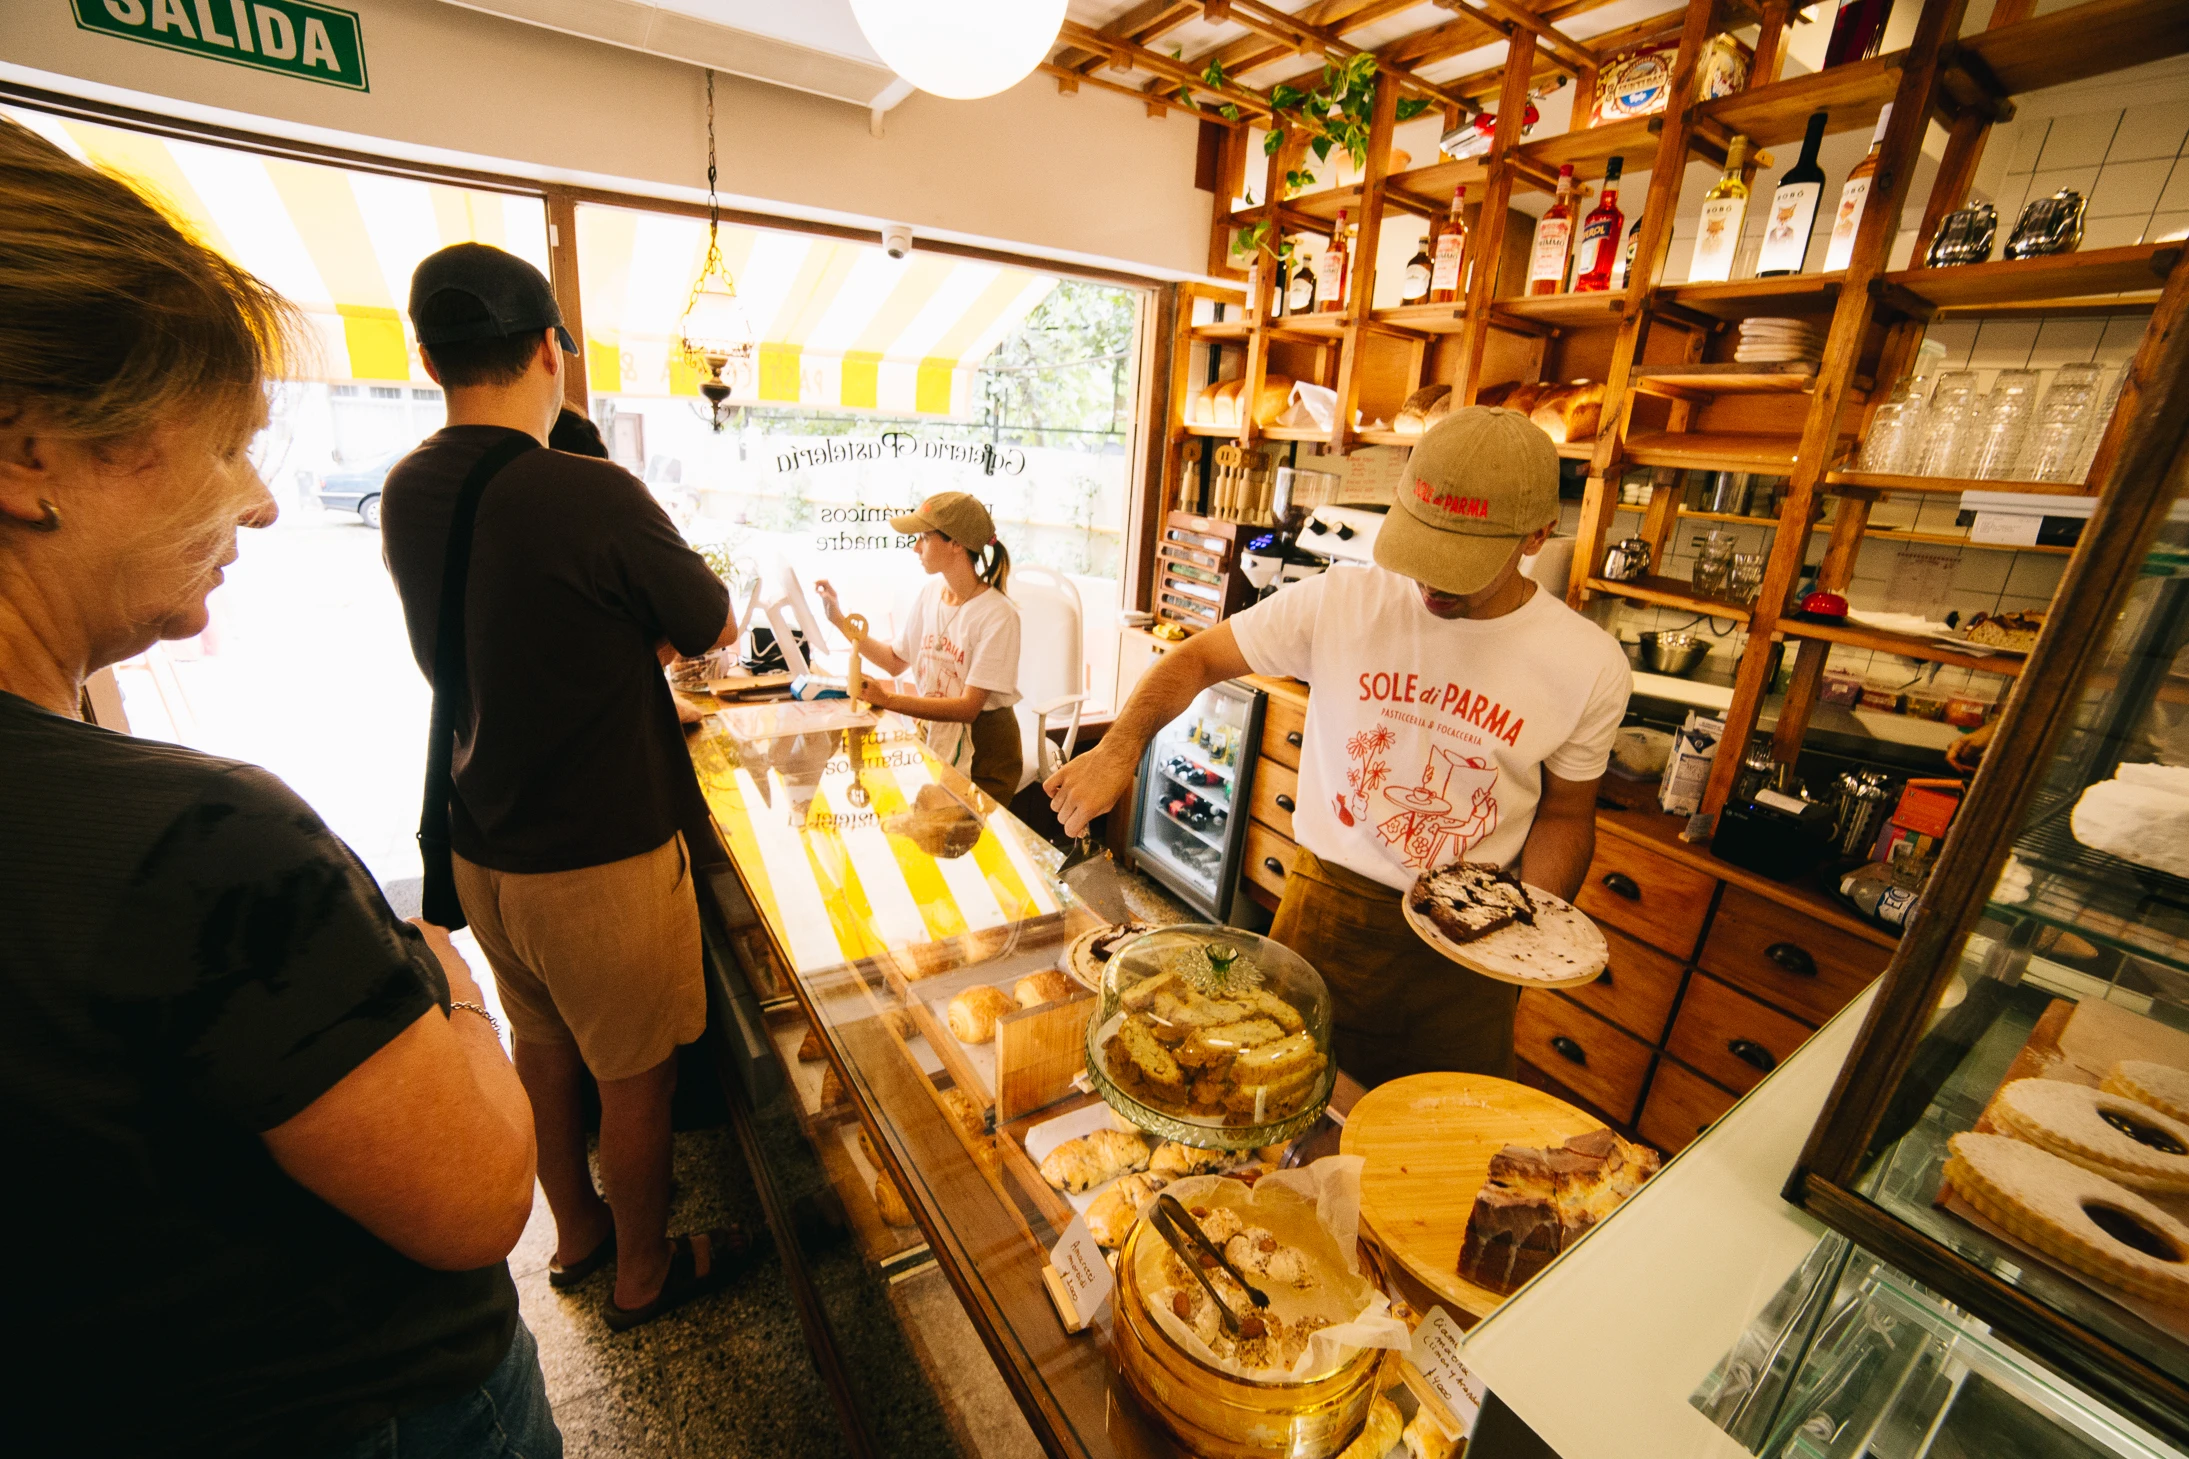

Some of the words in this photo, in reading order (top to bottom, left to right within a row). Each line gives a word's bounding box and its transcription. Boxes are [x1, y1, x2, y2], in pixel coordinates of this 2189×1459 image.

[1443, 494, 1489, 518] PARMA
[1359, 672, 1419, 703] SOLE
[1419, 686, 1443, 706] di
[1440, 682, 1525, 748] PARMA
[1381, 707, 1427, 729] PASTICCERIA
[1427, 720, 1435, 730] &
[1437, 723, 1483, 747] FOCACCERIA
